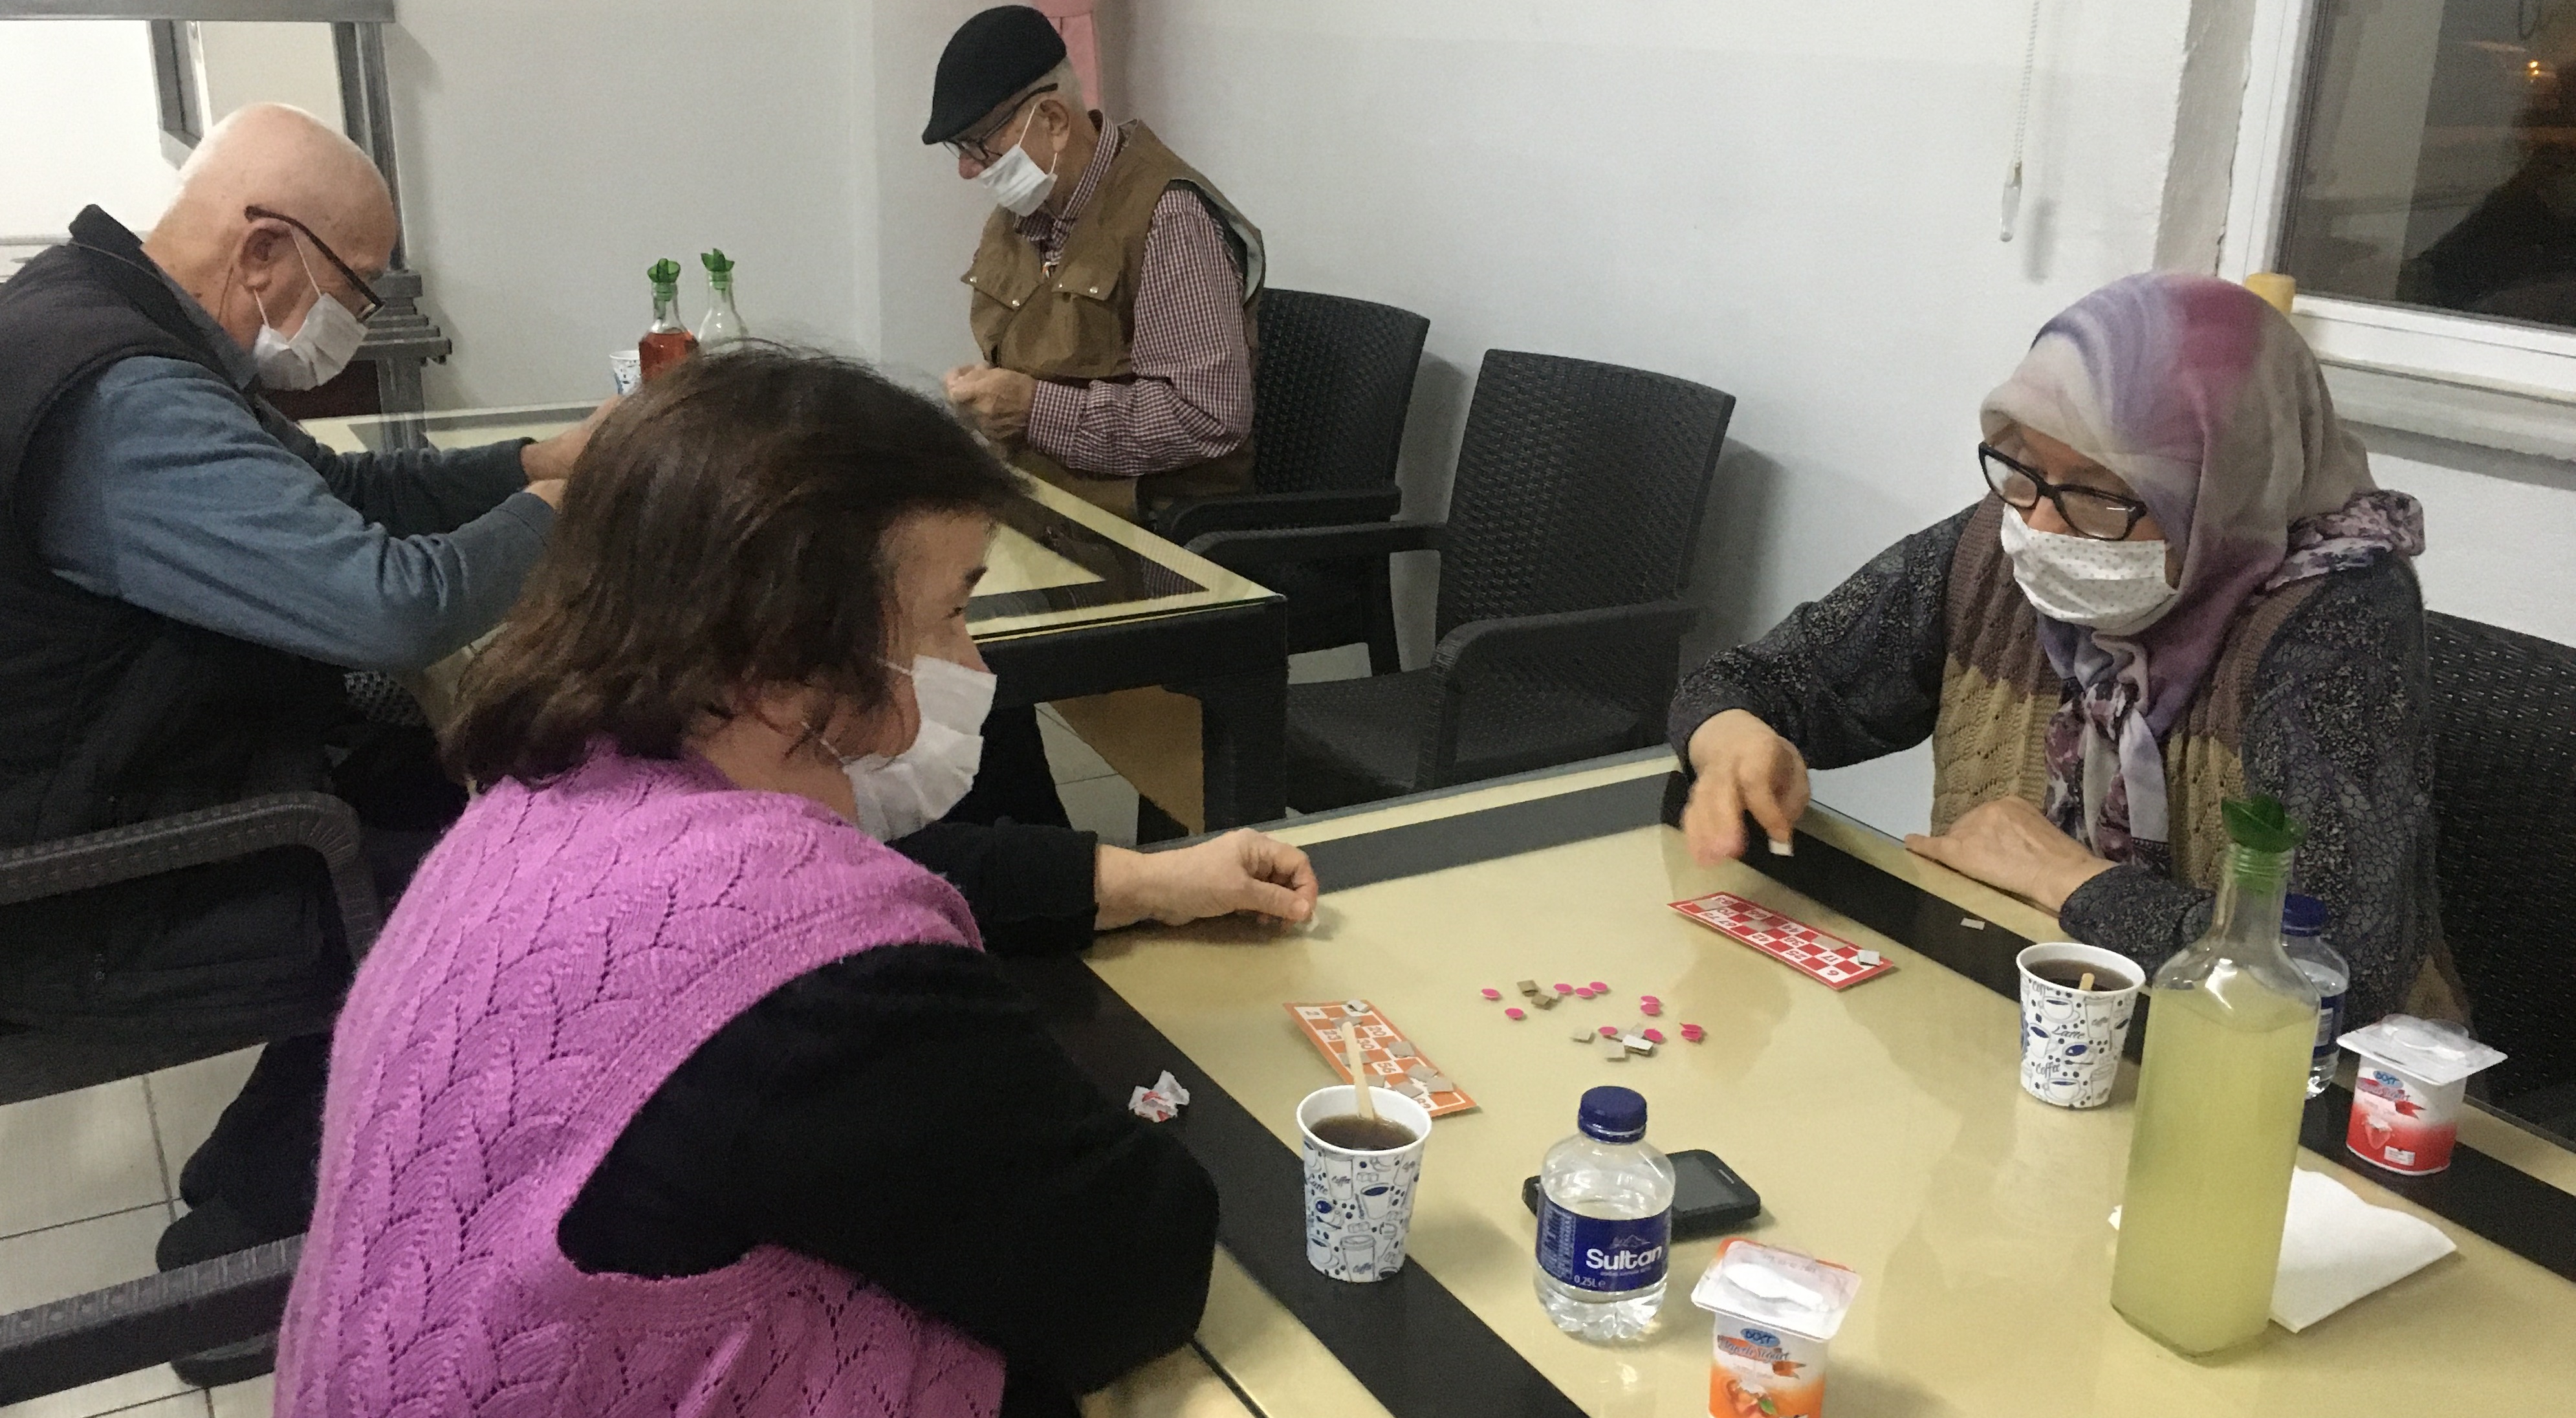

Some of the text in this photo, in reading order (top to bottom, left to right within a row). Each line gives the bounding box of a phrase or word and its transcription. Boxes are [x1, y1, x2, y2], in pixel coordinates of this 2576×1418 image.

[1751, 933, 1769, 942] 42
[1785, 950, 1807, 960] 25
[1821, 955, 1839, 963] 17
[1322, 1029, 1342, 1040] 23
[1367, 1025, 1386, 1036] 20
[1357, 1038, 1375, 1051] 30
[1377, 1062, 1396, 1074] 56
[1586, 1245, 1663, 1270] Sultan
